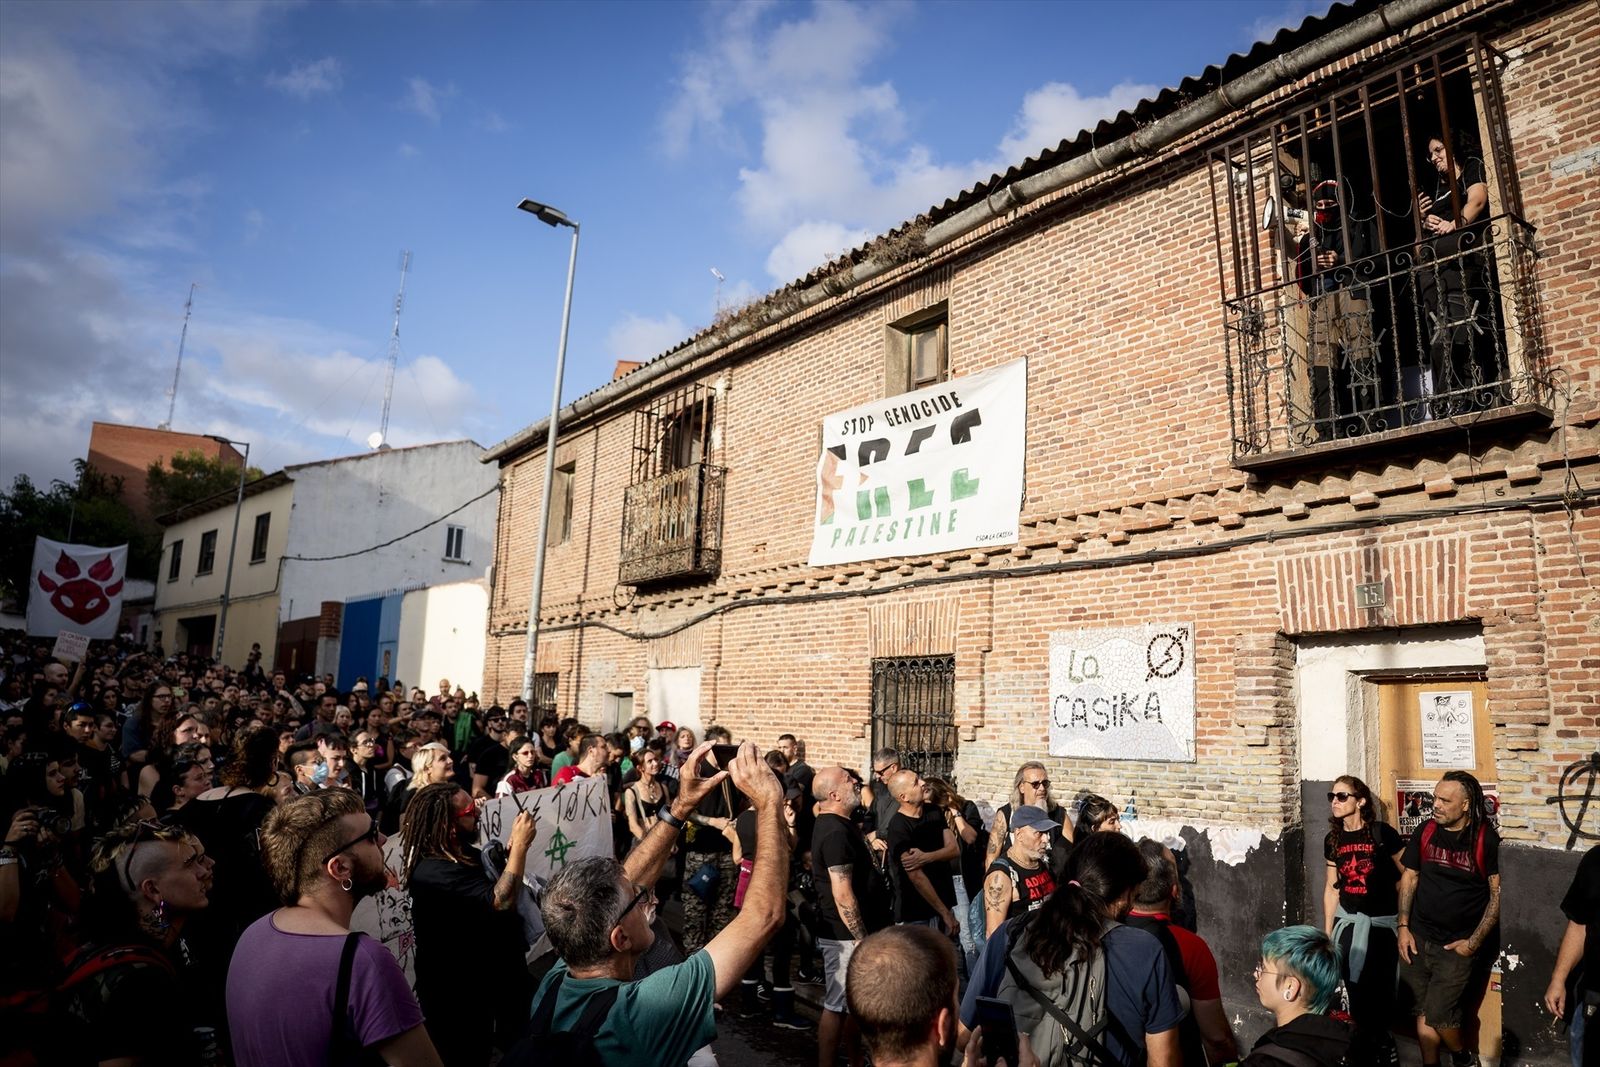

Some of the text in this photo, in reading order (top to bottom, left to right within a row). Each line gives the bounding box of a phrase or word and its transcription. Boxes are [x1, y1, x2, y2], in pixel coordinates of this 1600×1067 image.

[842, 391, 963, 436] STOP GENOCIDE
[831, 509, 958, 548] PALESTINE
[1363, 586, 1378, 605] 15
